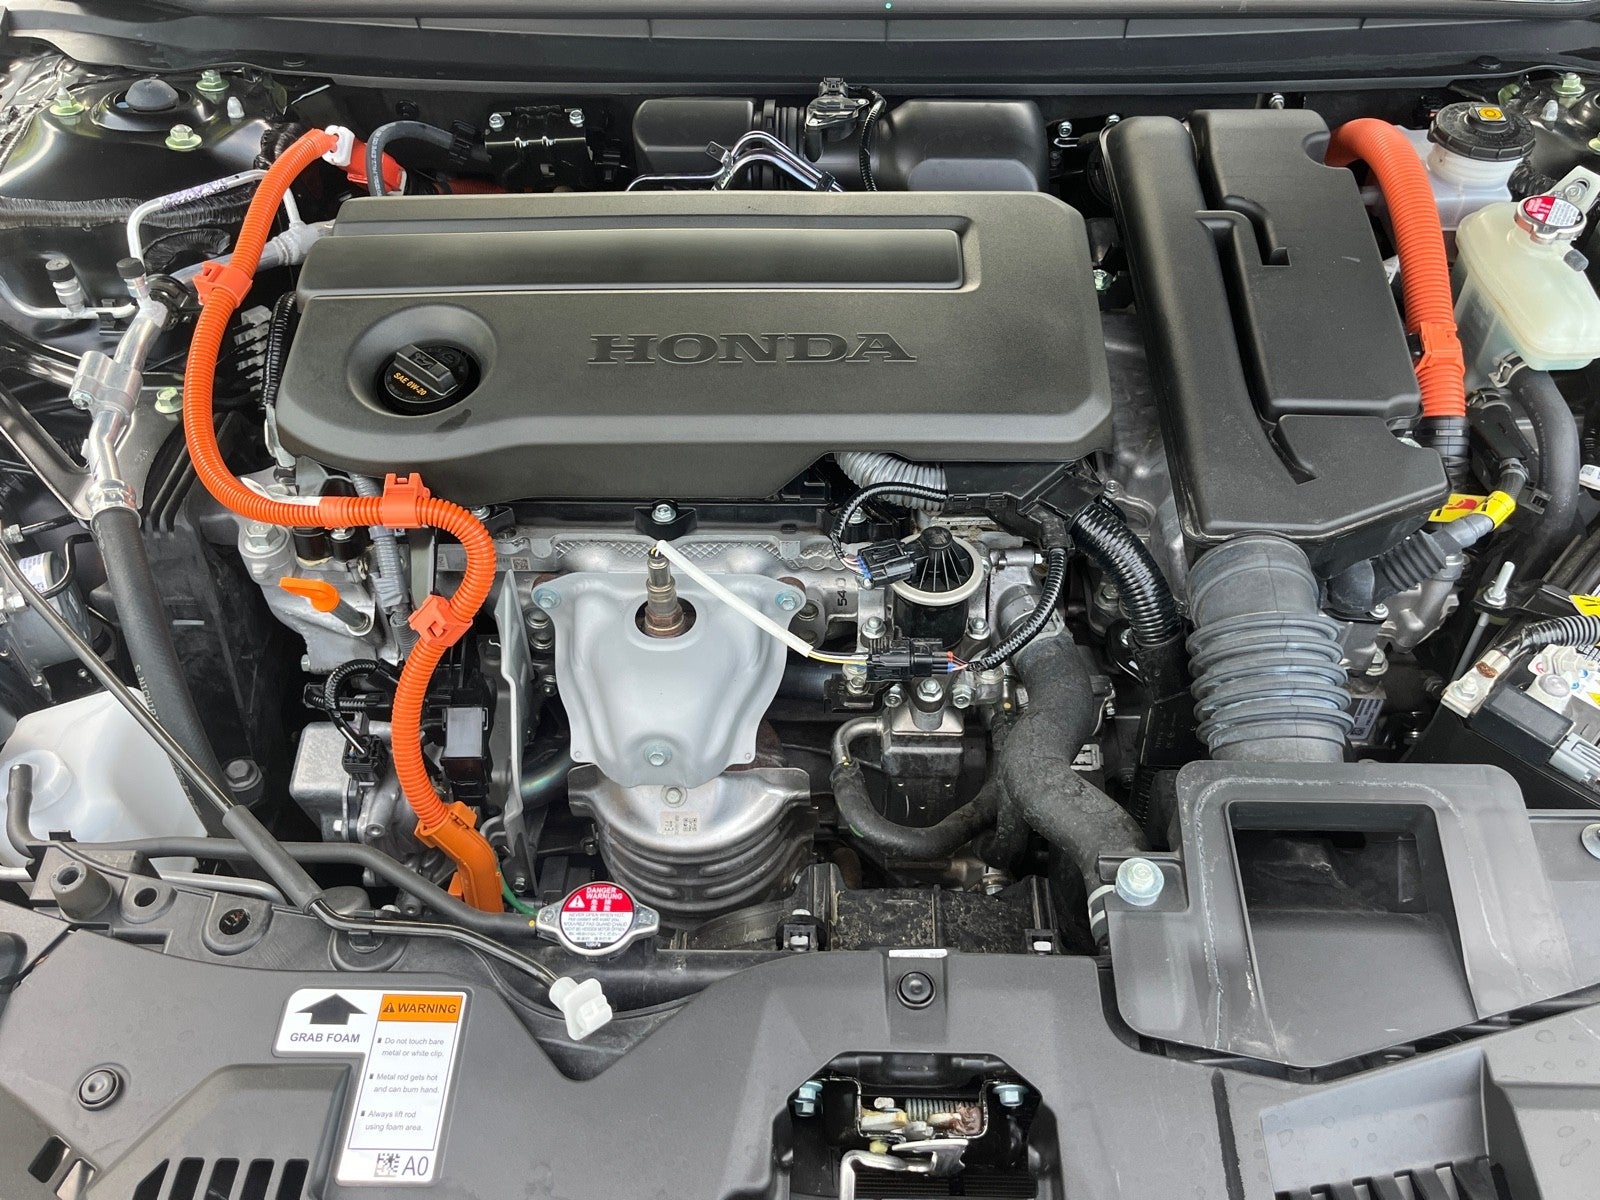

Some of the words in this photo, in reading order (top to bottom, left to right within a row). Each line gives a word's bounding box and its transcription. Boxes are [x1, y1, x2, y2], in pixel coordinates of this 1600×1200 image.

[587, 332, 917, 364] HONDA
[393, 372, 409, 384] SAE
[406, 378, 427, 396] 0W-20
[398, 1003, 458, 1014] WARNING
[289, 1032, 323, 1043] GRAB
[326, 1033, 361, 1044] FOAM
[384, 1037, 395, 1045] Do
[396, 1037, 407, 1045] not
[408, 1037, 428, 1045] touch
[428, 1037, 444, 1046] bare
[381, 1049, 401, 1057] metal
[411, 1049, 430, 1057] white
[430, 1050, 444, 1059] clip.
[376, 1073, 396, 1081] Metal
[397, 1073, 409, 1081] rod
[410, 1074, 425, 1082] gets
[373, 1085, 387, 1093] and
[403, 1085, 419, 1093] burn
[420, 1086, 440, 1094] hand.
[367, 1110, 393, 1119] Always
[393, 1110, 404, 1118] lift
[365, 1123, 384, 1132] using
[385, 1123, 404, 1131] foam
[401, 1155, 429, 1176] A0
